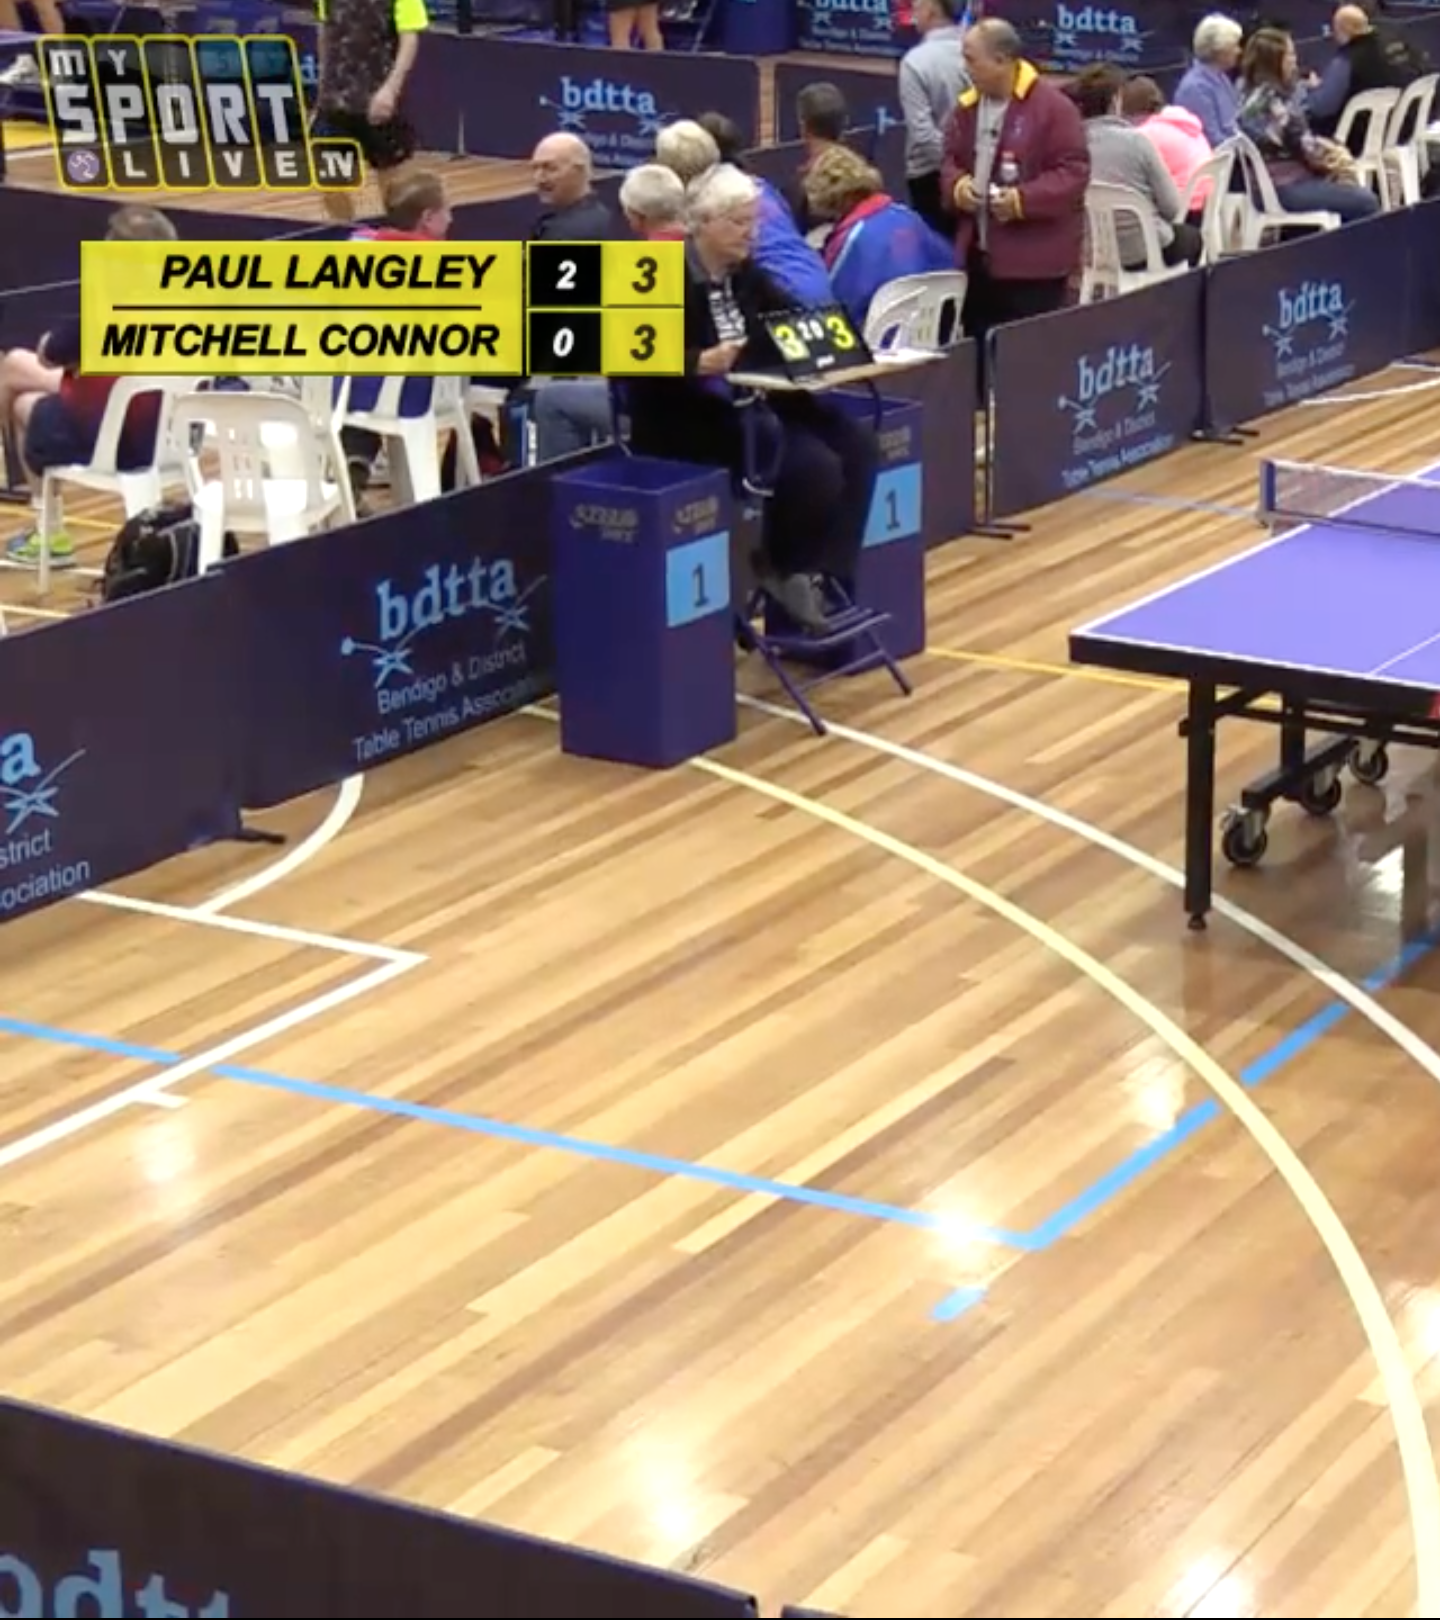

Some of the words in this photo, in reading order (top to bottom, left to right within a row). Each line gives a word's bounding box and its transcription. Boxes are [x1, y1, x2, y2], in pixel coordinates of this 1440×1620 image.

[1057, 4, 1137, 34] bdtta
[560, 76, 657, 114] bdtta
[1278, 279, 1344, 330] bdtta
[773, 324, 810, 359] 3
[826, 315, 855, 349] 3
[1077, 343, 1154, 401] bdtta
[885, 488, 900, 531] 1
[376, 555, 518, 641] bdtta
[692, 562, 710, 608] 1
[376, 674, 447, 715] Bendigo
[450, 662, 465, 687] &
[468, 638, 527, 680] District
[352, 727, 399, 762] Table
[401, 705, 461, 744] Tennis
[0, 828, 53, 870] strict
[0, 860, 92, 910] ociation
